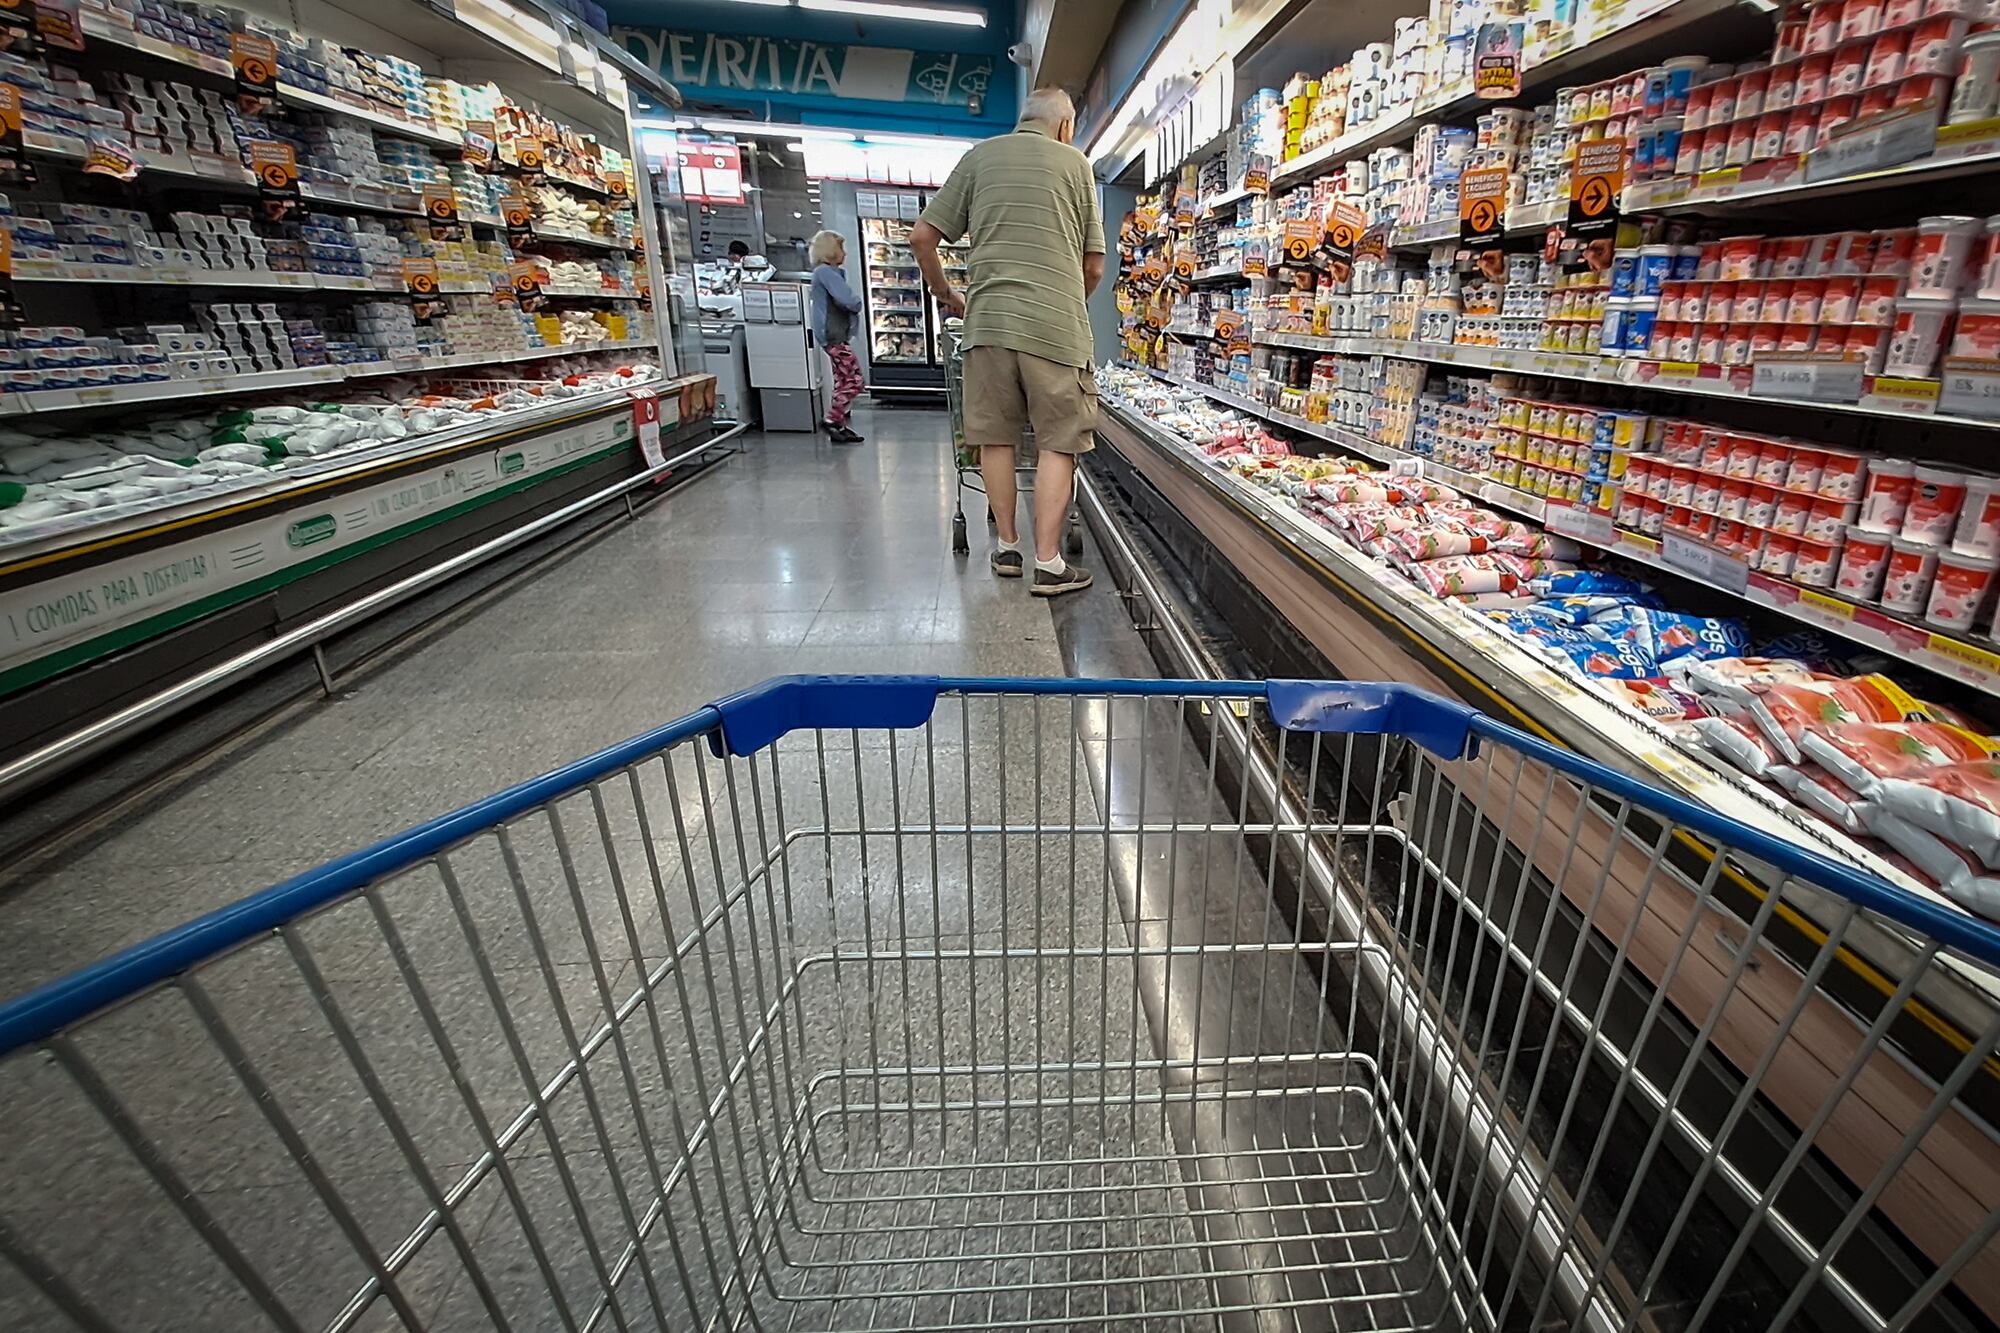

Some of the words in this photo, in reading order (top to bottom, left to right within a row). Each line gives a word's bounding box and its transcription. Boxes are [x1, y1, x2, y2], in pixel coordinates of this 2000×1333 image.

[1579, 143, 1622, 157] BENEFICIO
[1578, 154, 1620, 166] EXCLUSIVO
[1465, 173, 1503, 184] BENEFICIO
[1465, 182, 1502, 193] EXCLUSIVO
[26, 589, 98, 634] COMIDAS
[102, 576, 139, 610] PARA
[143, 555, 209, 597] DISFRUTAR
